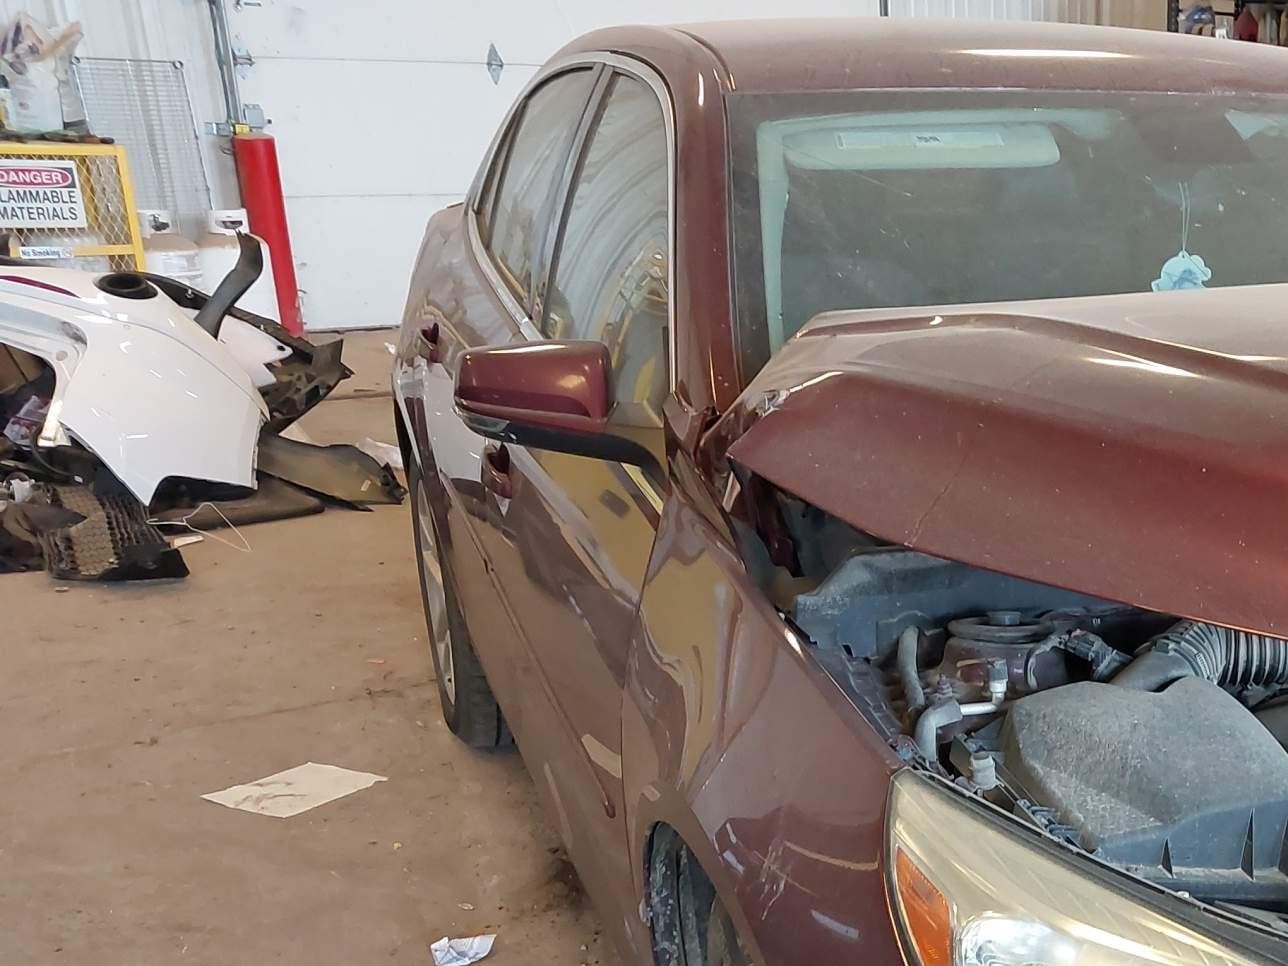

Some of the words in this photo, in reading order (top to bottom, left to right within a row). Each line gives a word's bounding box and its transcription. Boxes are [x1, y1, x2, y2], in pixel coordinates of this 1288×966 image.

[0, 170, 63, 184] DANGER
[0, 189, 77, 204] LAMMABLE
[0, 206, 78, 221] MATERIALS
[31, 248, 61, 258] Smoking
